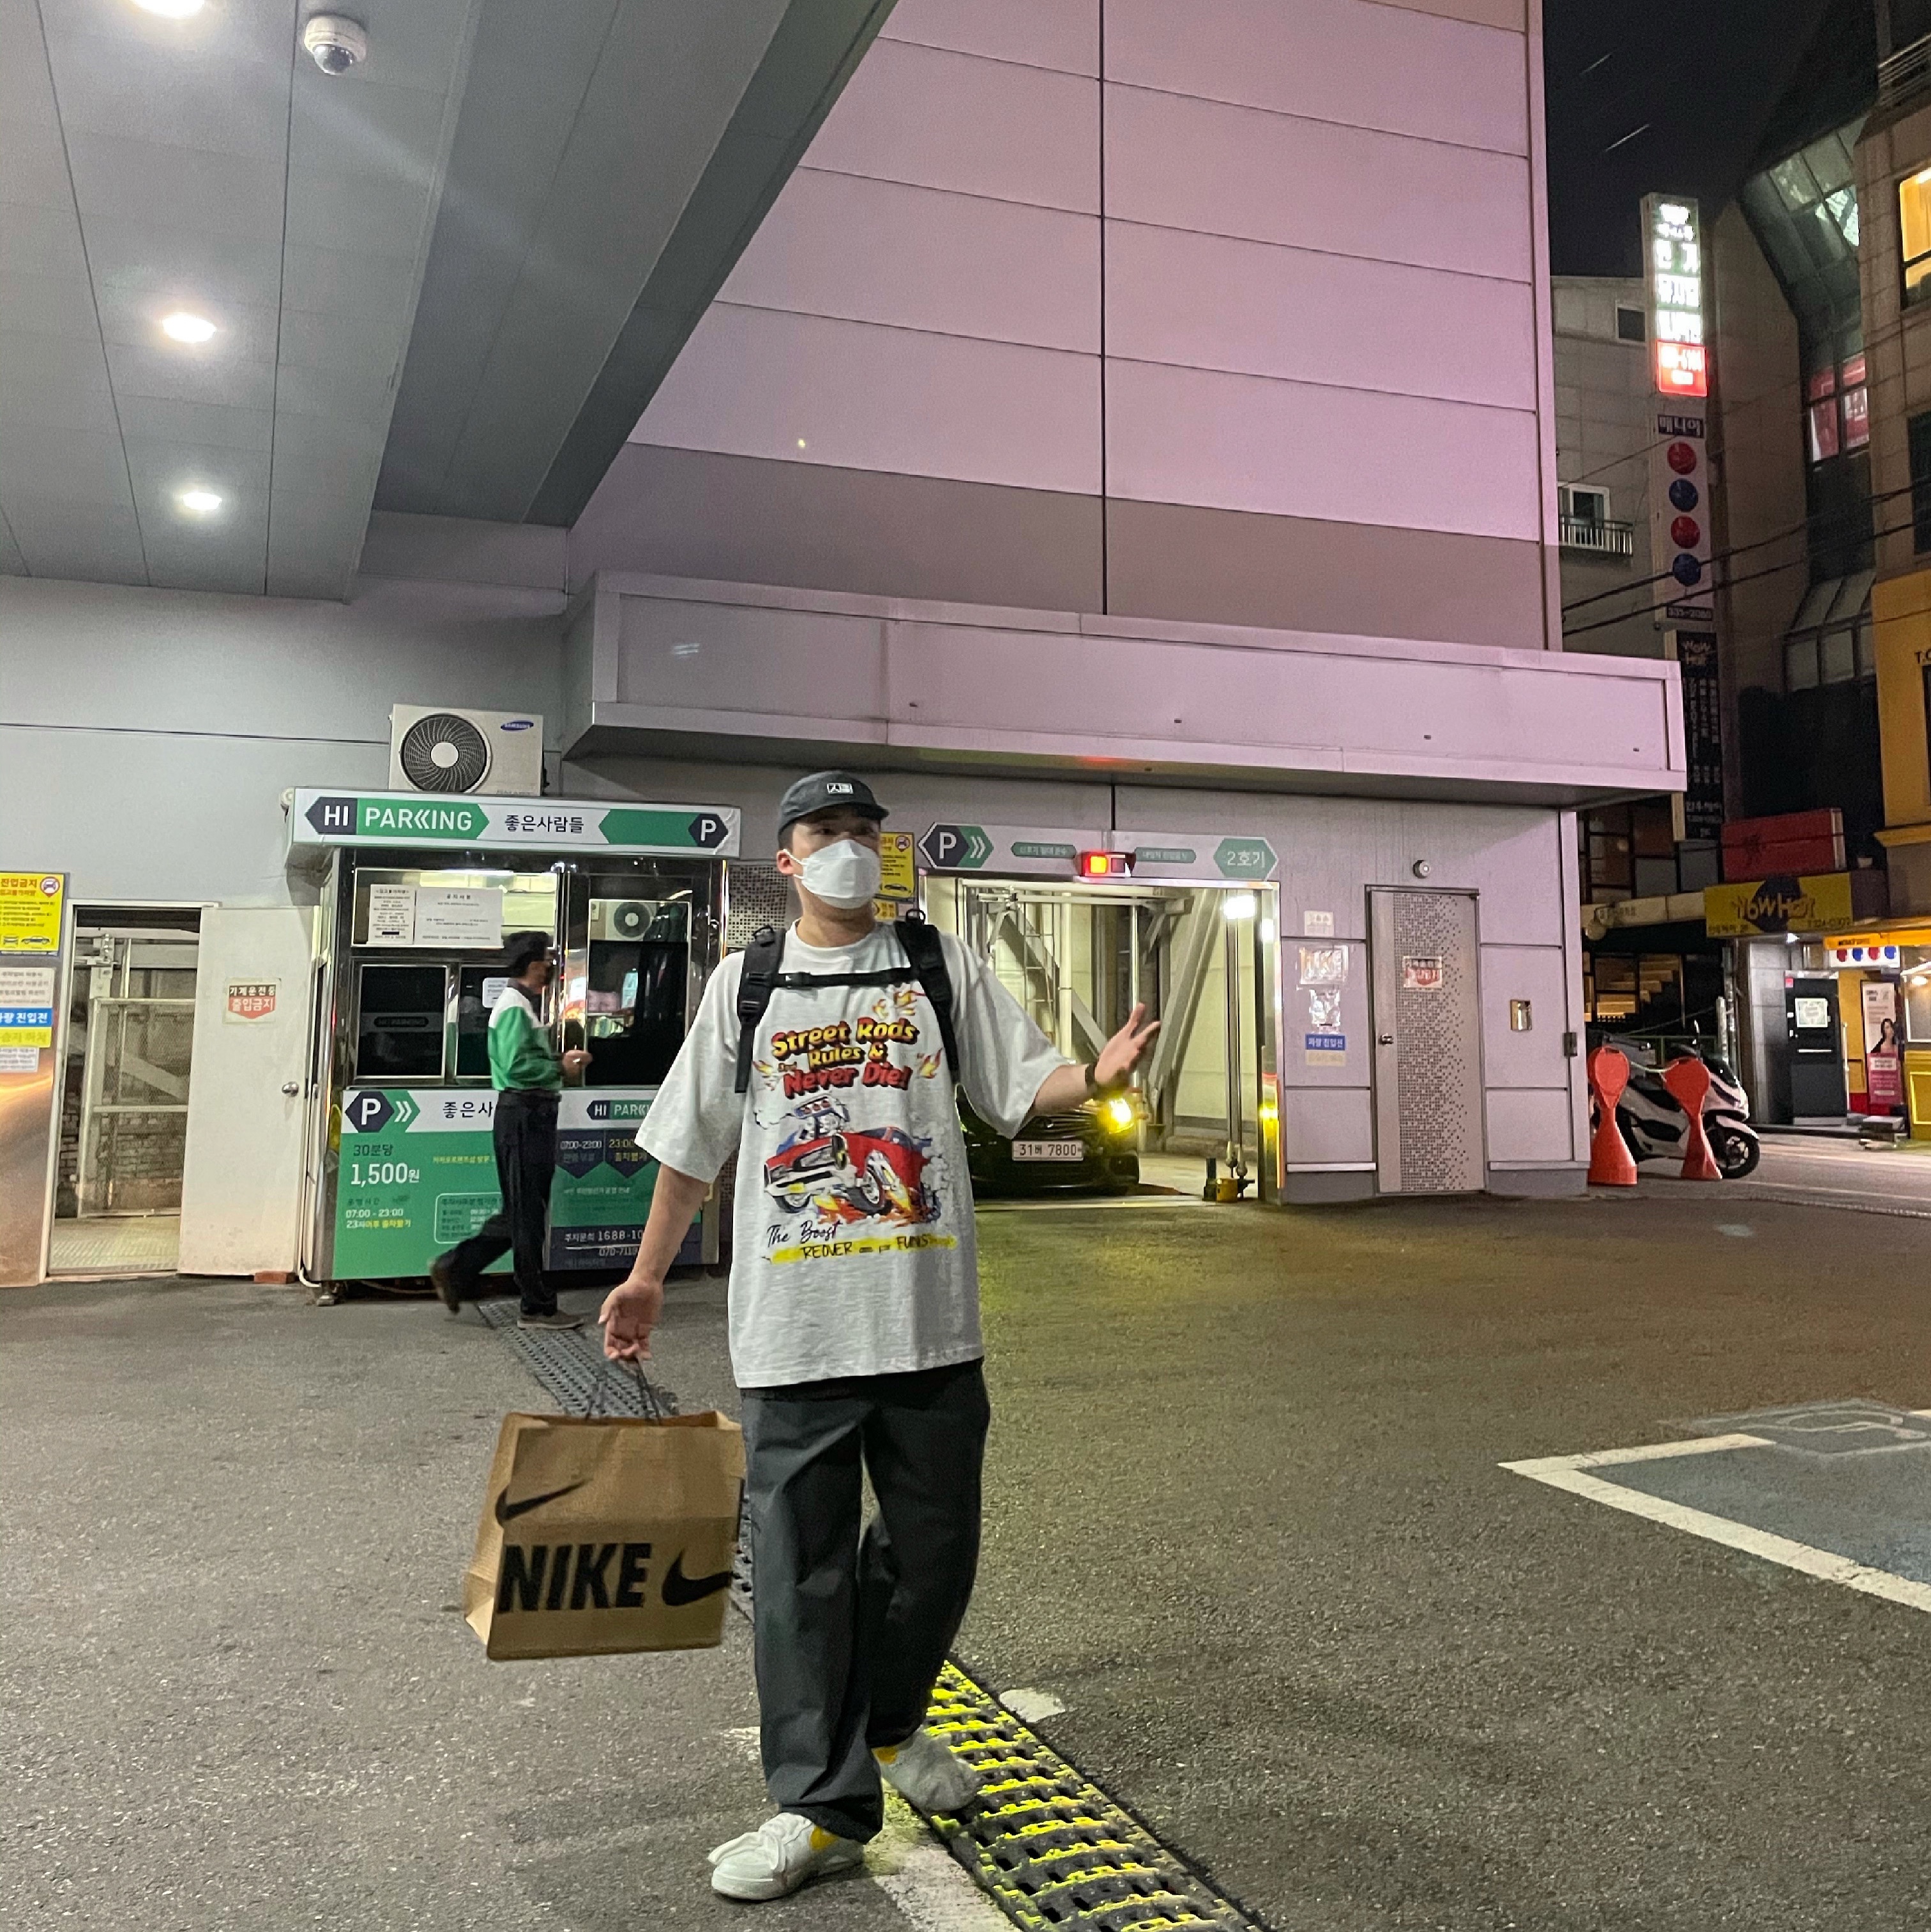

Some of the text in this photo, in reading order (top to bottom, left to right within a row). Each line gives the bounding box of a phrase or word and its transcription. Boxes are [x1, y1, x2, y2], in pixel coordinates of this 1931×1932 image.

[324, 805, 472, 830] HI PARKING
[504, 814, 584, 833] 좋은사람들
[700, 819, 717, 841] P
[939, 832, 957, 859] P
[1227, 851, 1265, 868] 2호기
[230, 985, 275, 996] 기계운전중
[232, 998, 273, 1012] 출입금지
[17, 1012, 48, 1024] 진입전
[771, 1017, 920, 1061] Street Rods
[808, 1042, 888, 1070] Rules &
[783, 1061, 913, 1099] Never Die!
[361, 1098, 382, 1125] P
[443, 1101, 494, 1118] 좋은사
[594, 1104, 606, 1116] HI
[353, 1144, 394, 1157] 30분당
[1048, 1145, 1077, 1156] 7800
[351, 1162, 420, 1187] 1,500원
[345, 1209, 370, 1219] 07:00
[378, 1208, 404, 1217] 23:00
[767, 1224, 790, 1245] The
[497, 1542, 653, 1615] NIKE
